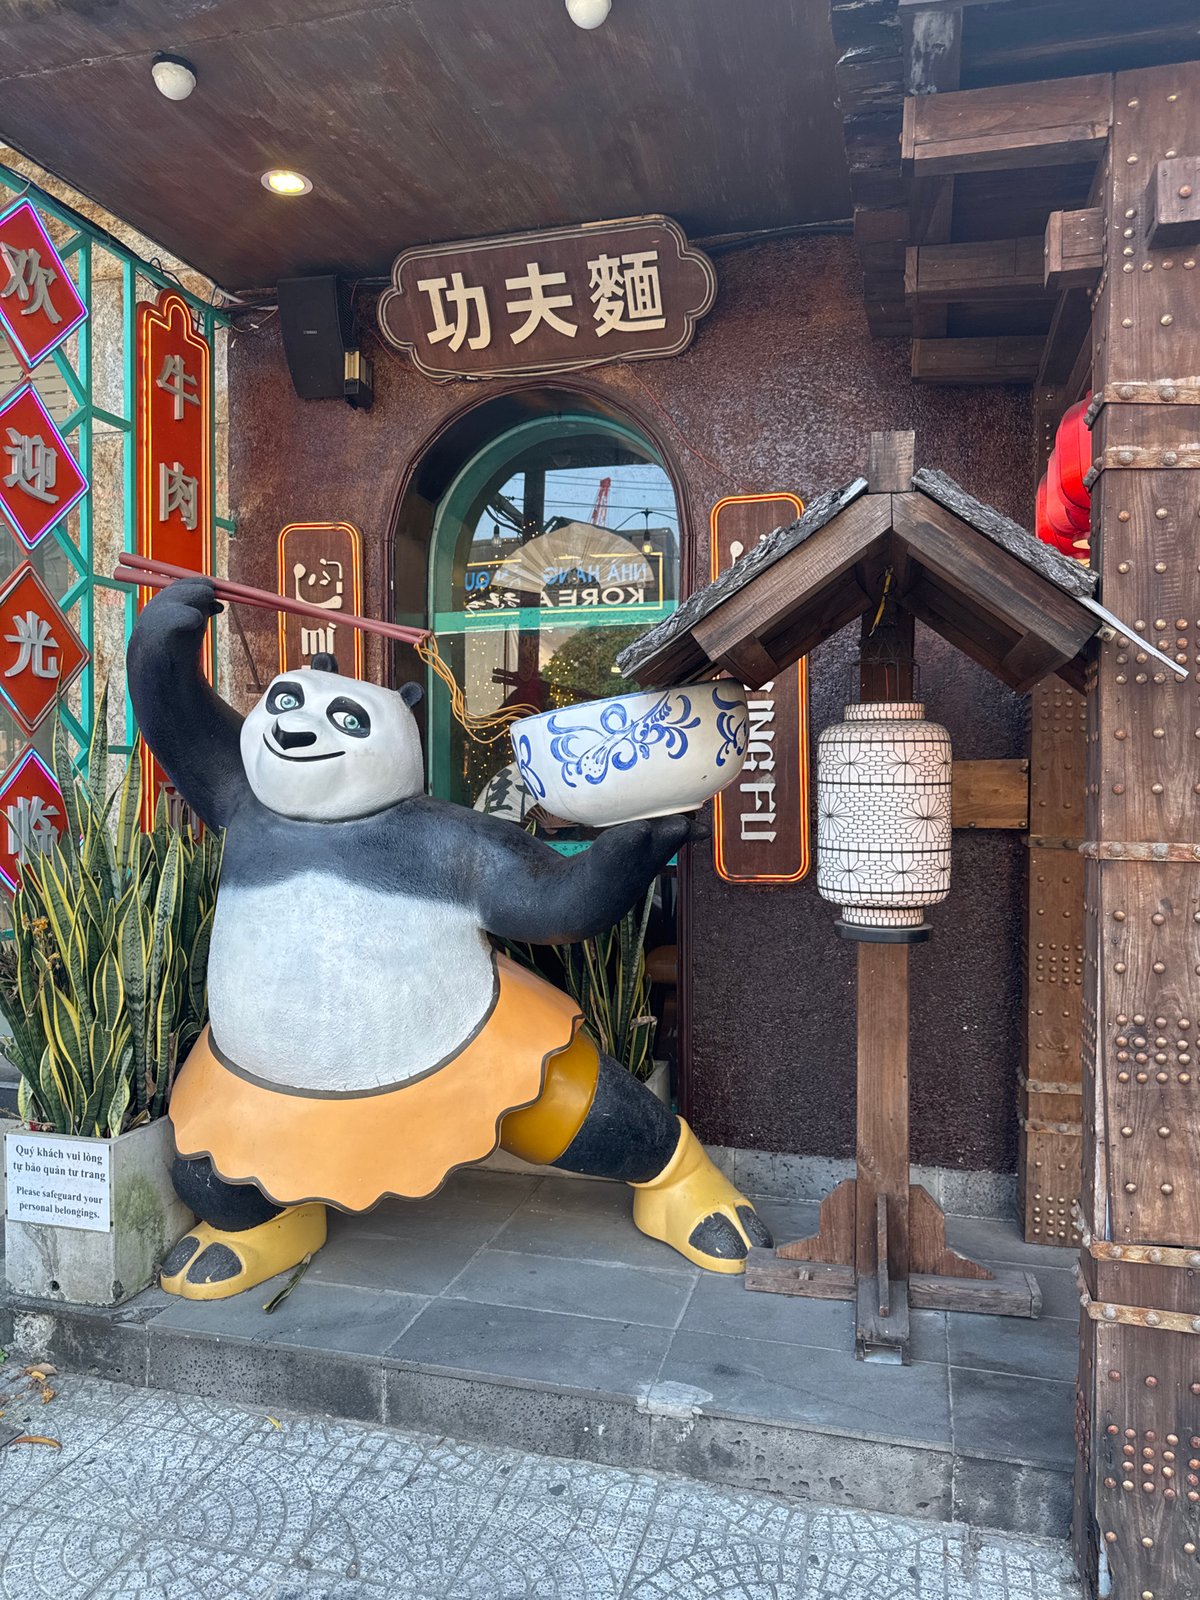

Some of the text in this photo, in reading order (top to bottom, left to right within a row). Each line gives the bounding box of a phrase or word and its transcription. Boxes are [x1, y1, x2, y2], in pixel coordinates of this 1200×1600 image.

[417, 250, 666, 353] 功夫麵
[740, 783, 778, 843] FU
[15, 1144, 103, 1165] Quý khách vui lòng
[13, 1162, 106, 1182] tự bảo quản tư trang
[16, 1186, 104, 1205] Please safeguard your
[19, 1202, 100, 1219] personal belongings.
